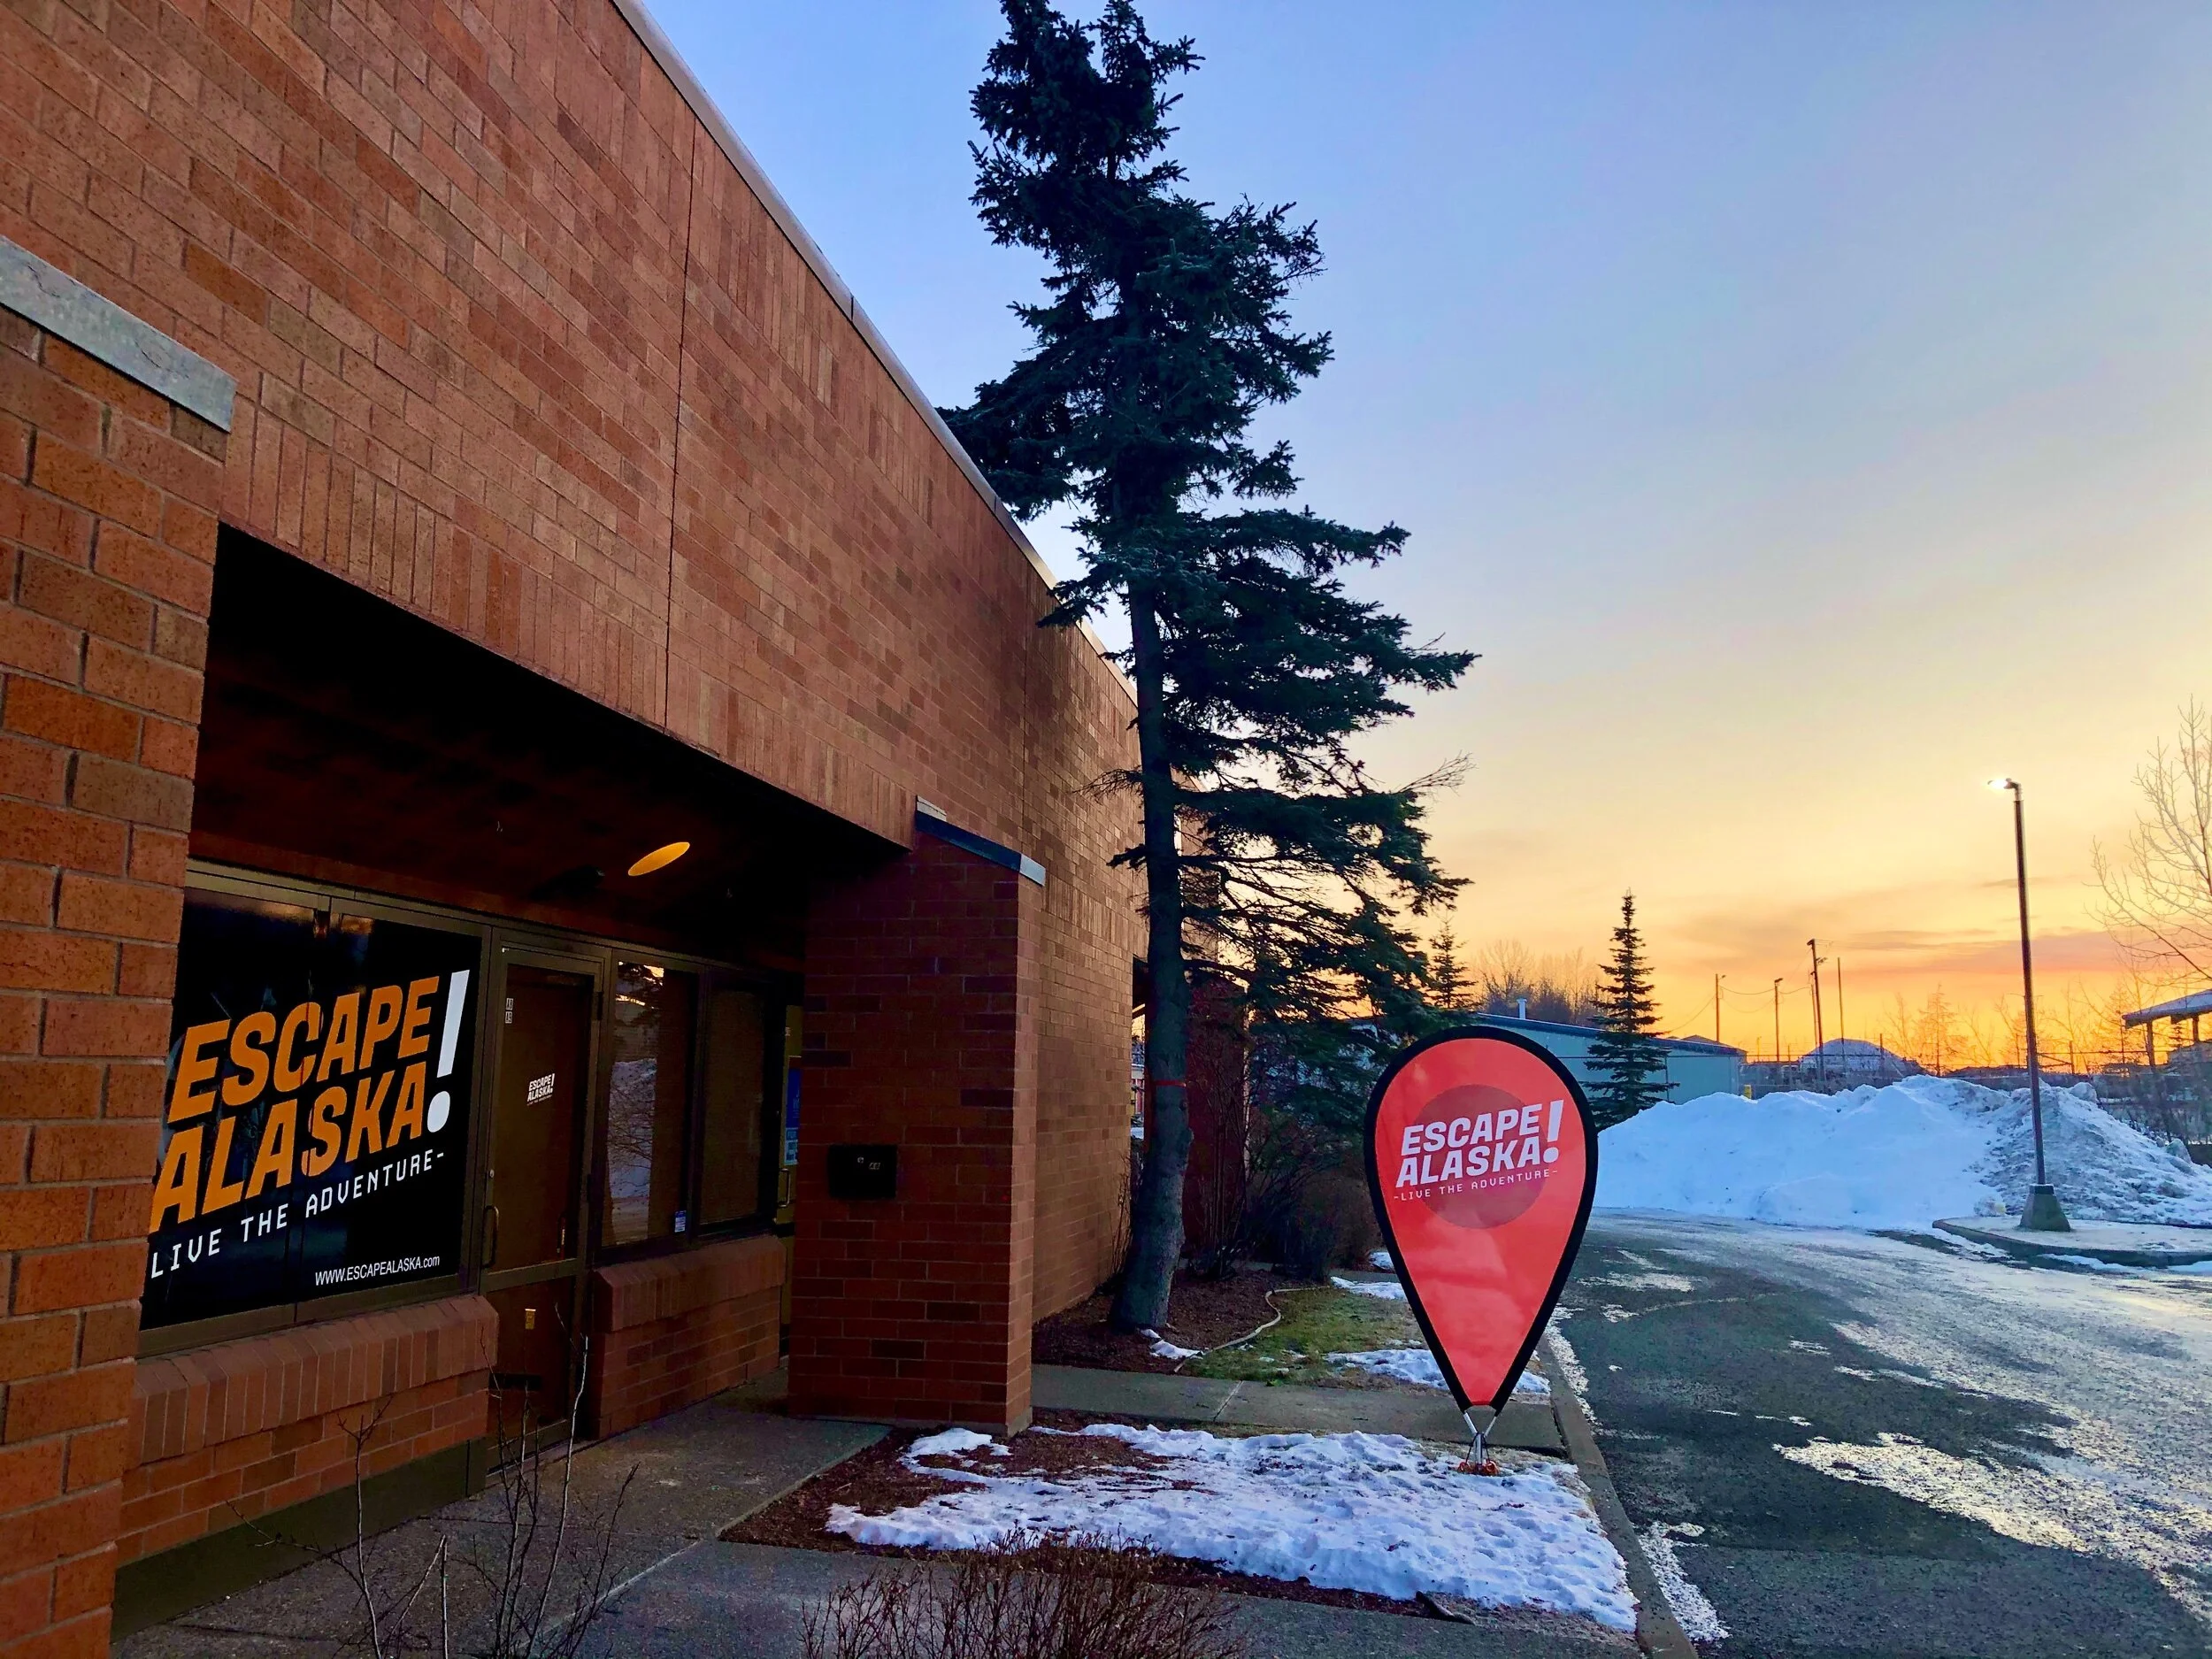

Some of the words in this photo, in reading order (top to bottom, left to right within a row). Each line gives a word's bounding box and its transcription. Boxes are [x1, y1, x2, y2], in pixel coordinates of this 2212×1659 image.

[167, 976, 440, 1124] ESCAPE
[528, 1074, 552, 1092] ESCAPE
[1401, 1103, 1543, 1156] ESCAPE
[1439, 1183, 1463, 1195] THE
[150, 1228, 223, 1279] LIVE
[240, 1203, 289, 1243] THE
[314, 1254, 441, 1286] WWW.ESCAPEALASKA.com
